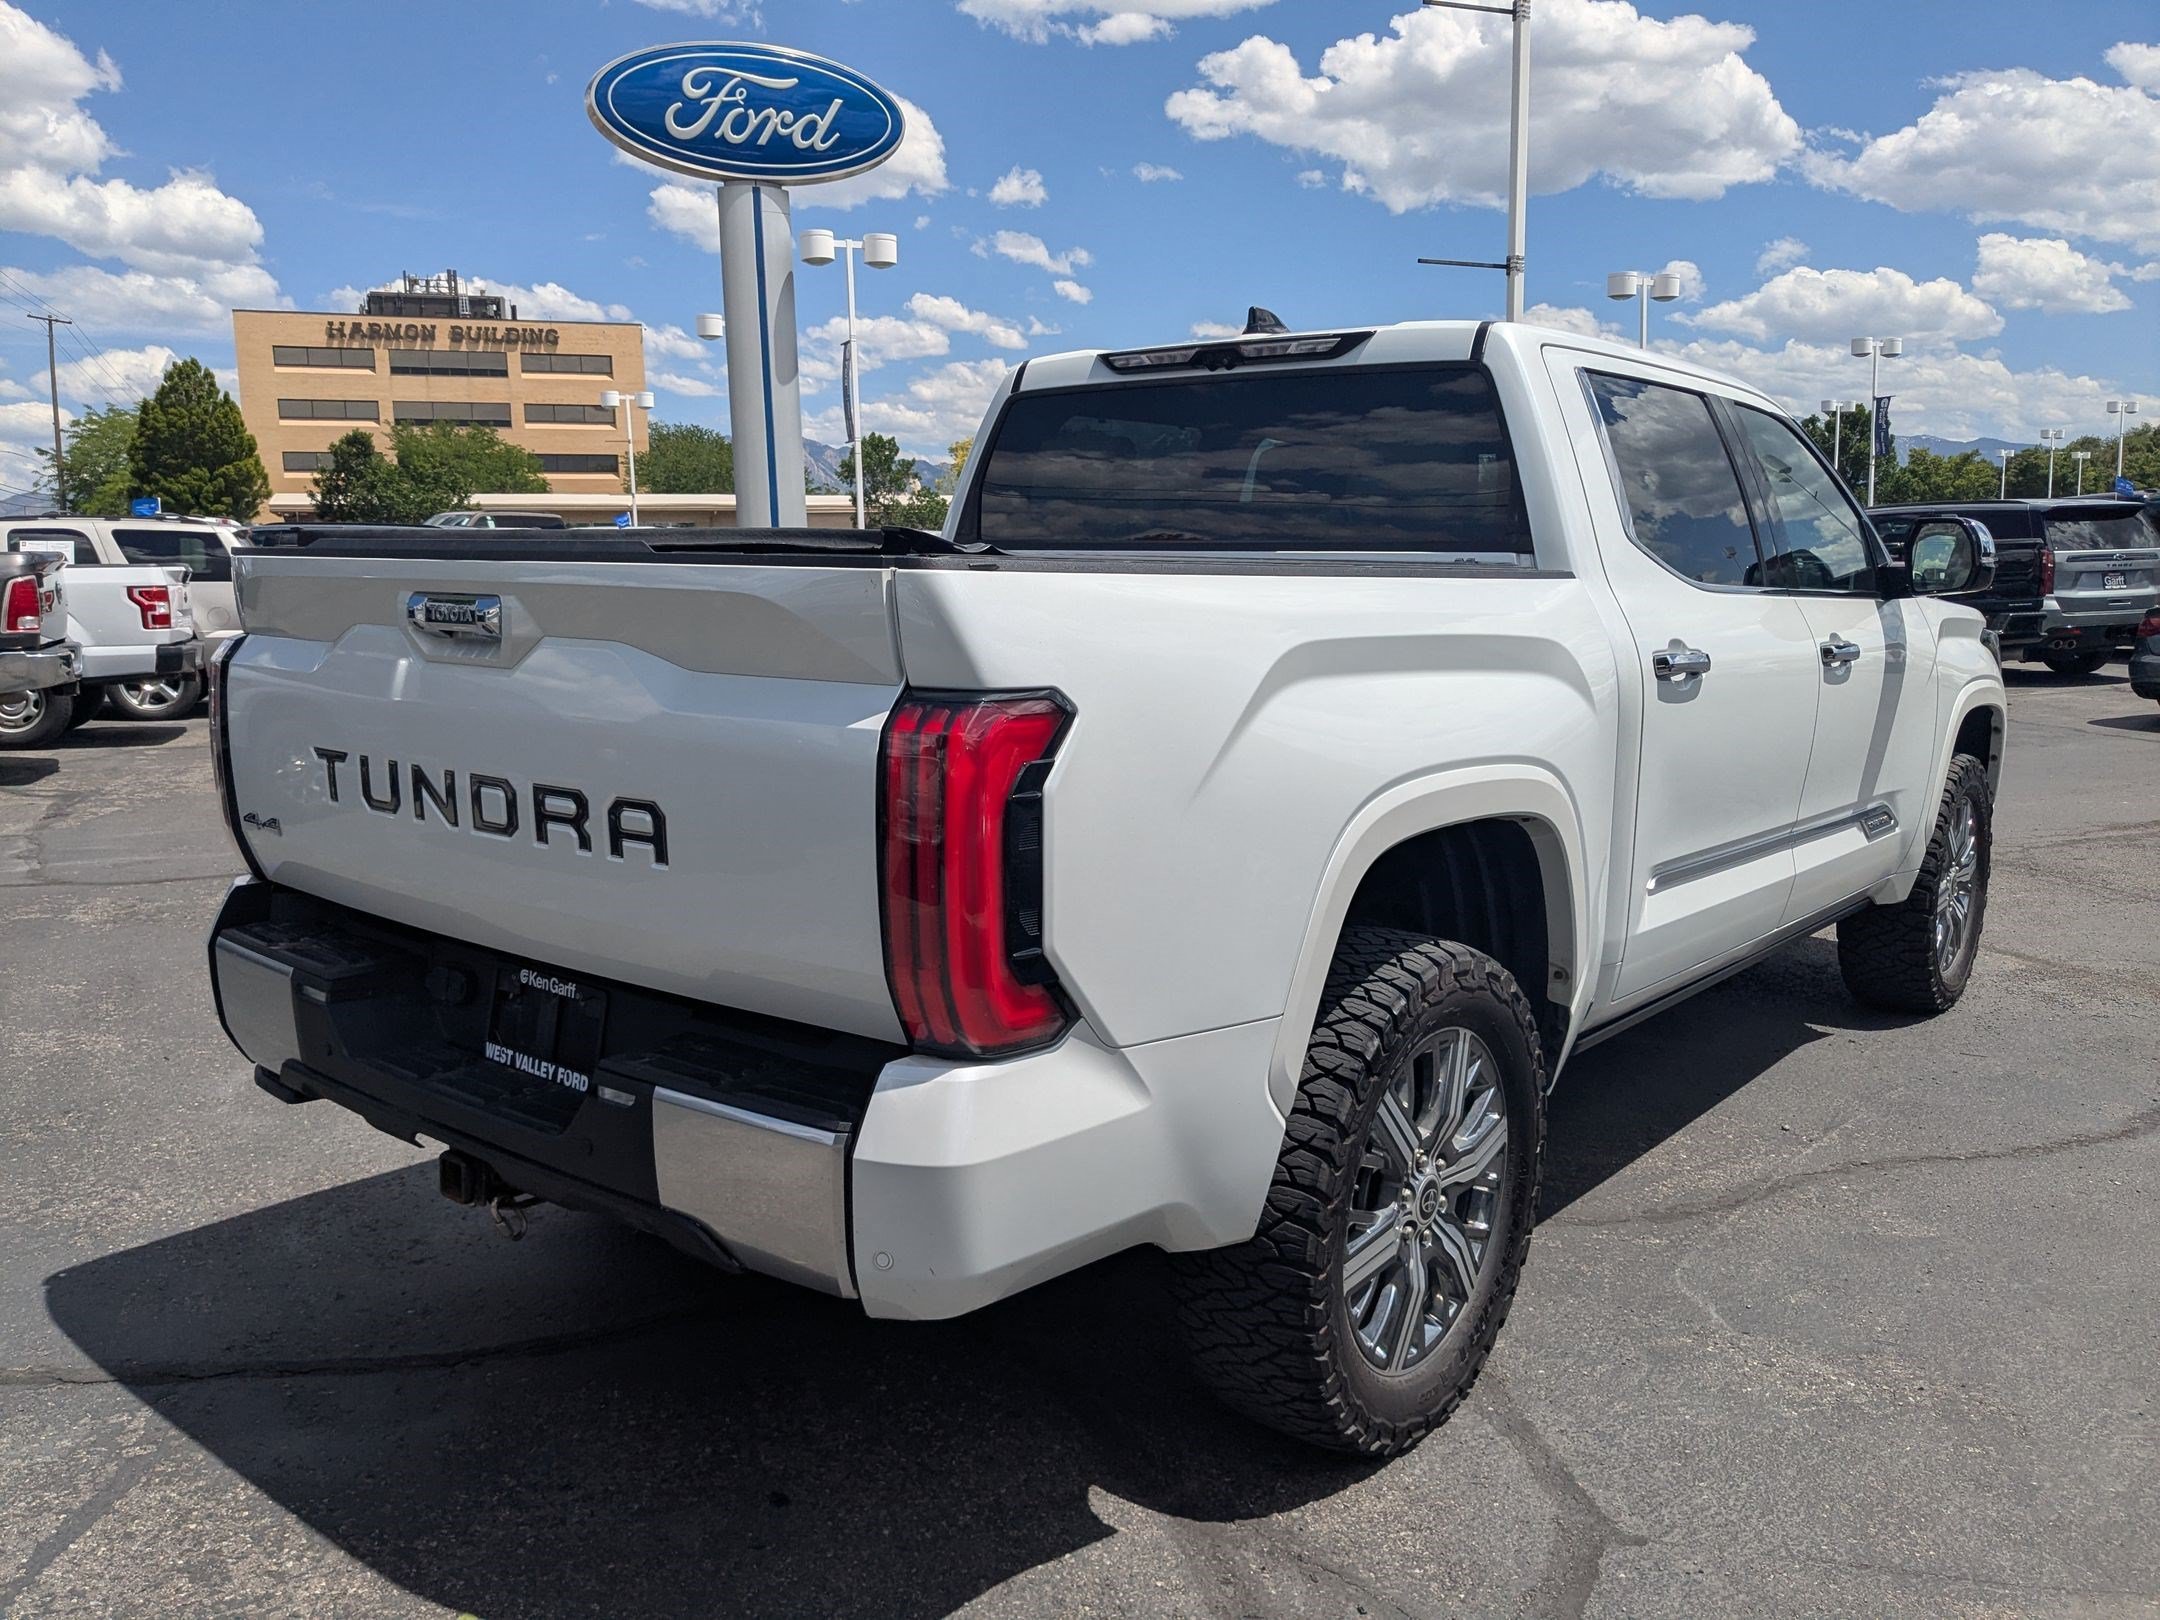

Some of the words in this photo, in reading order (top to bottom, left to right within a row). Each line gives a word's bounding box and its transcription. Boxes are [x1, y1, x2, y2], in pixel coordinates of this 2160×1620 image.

[664, 66, 844, 152] Ford
[326, 321, 437, 342] HARMON
[449, 324, 560, 346] BUILDING
[429, 604, 473, 622] TOYOTA
[312, 746, 669, 869] TUNDRA
[549, 977, 577, 999] Garff
[485, 1041, 513, 1066] WEST
[515, 1052, 556, 1081] VALLEY
[557, 1066, 589, 1093] FORD
